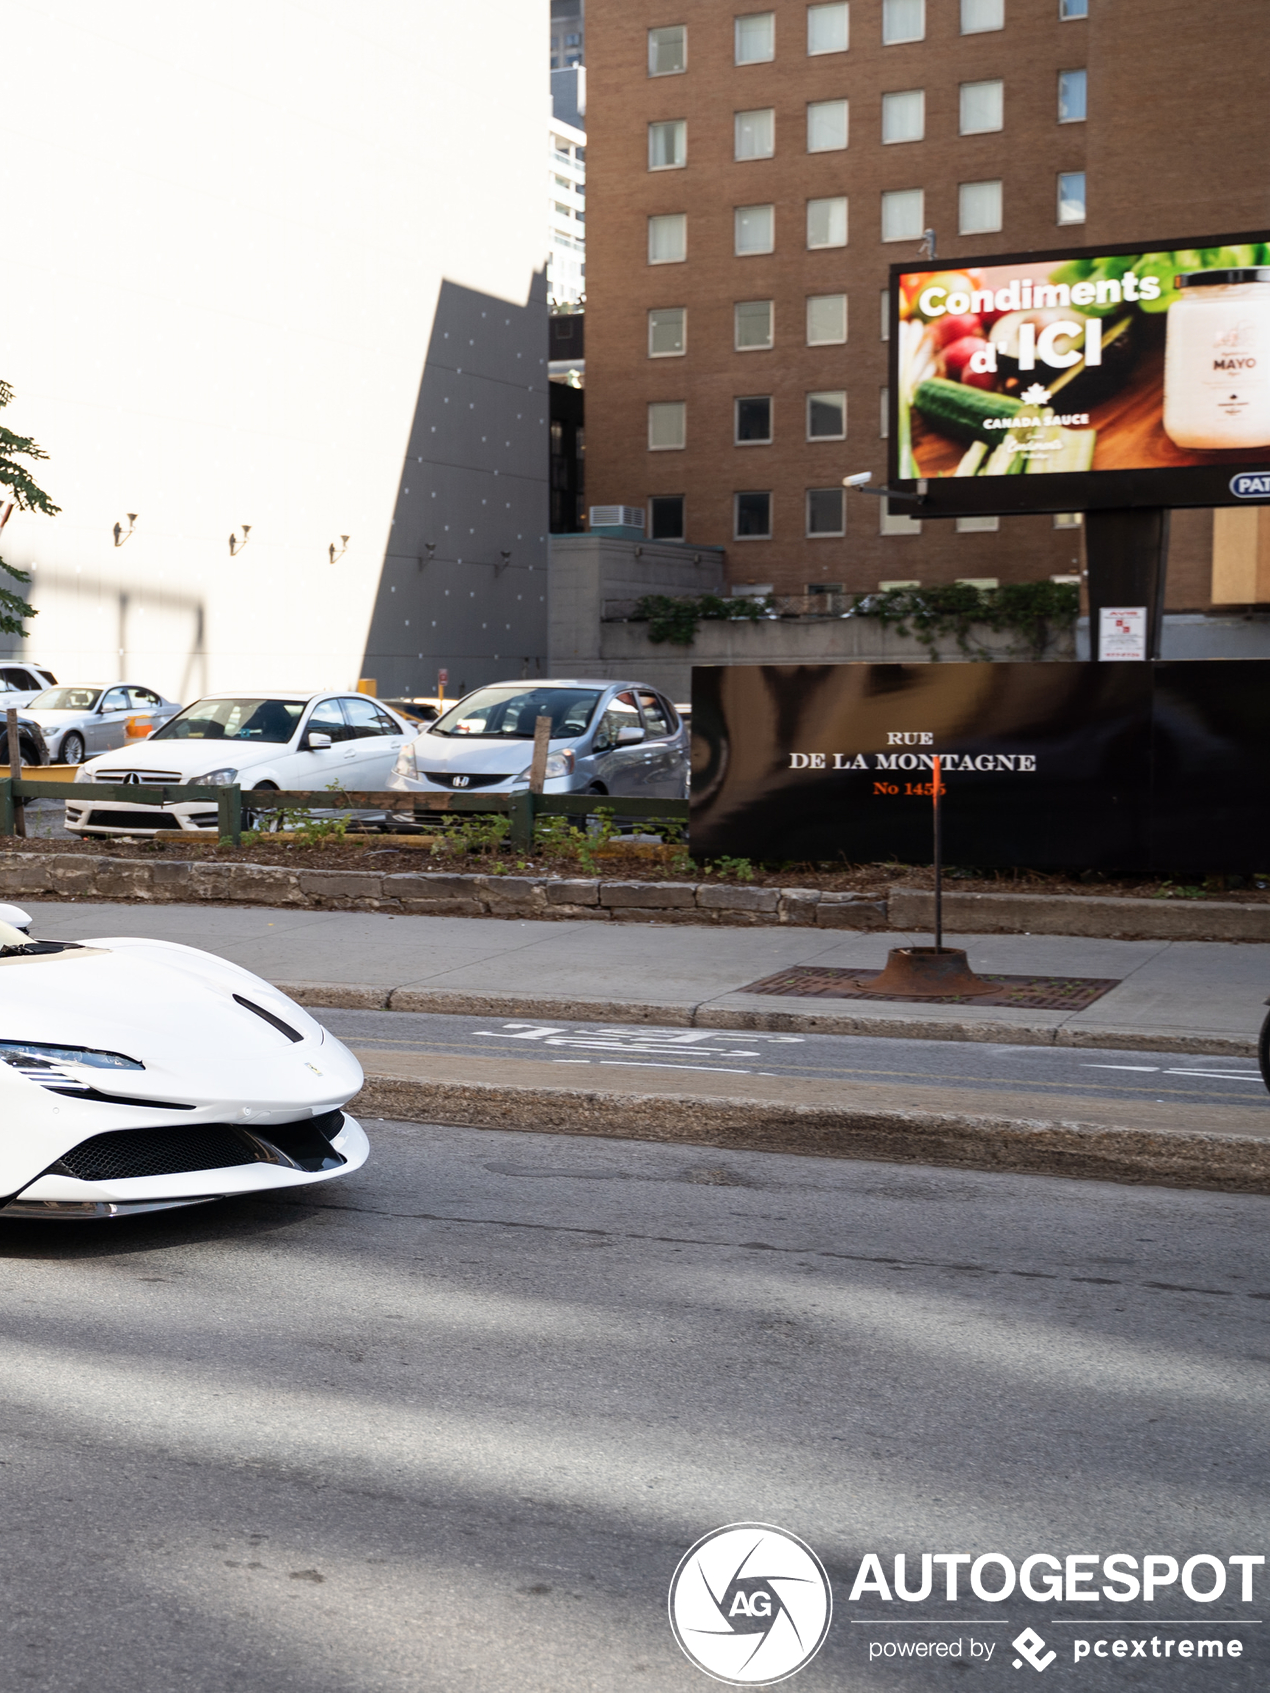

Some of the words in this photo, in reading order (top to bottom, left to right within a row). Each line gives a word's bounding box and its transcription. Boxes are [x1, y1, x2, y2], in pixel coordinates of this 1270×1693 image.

[919, 271, 1162, 318] Condiments
[1213, 358, 1256, 370] MAYO
[982, 416, 1041, 430] CANADA
[1043, 413, 1090, 427] SAUCE
[886, 732, 934, 745] RUE
[788, 753, 826, 770] DE
[832, 753, 869, 770] LA
[875, 753, 1037, 772] MONTAGNE
[873, 782, 899, 796] No
